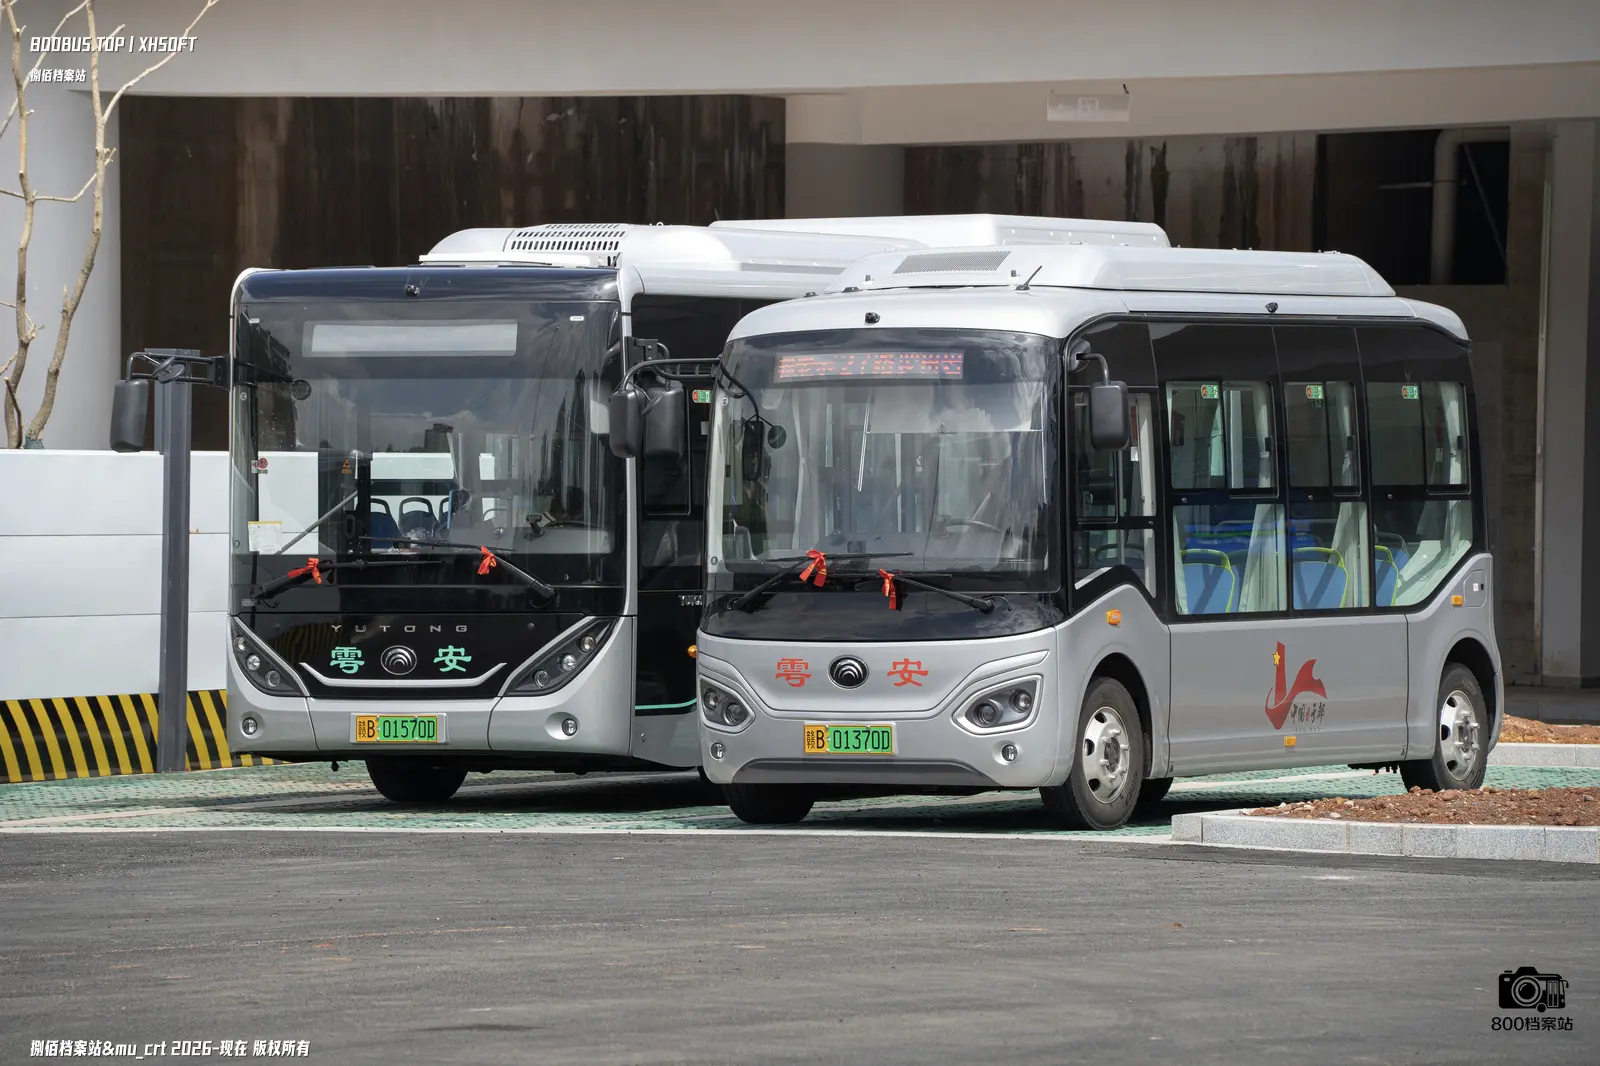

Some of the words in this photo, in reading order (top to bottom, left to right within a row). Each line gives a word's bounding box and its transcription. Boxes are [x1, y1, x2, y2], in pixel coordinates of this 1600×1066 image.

[331, 625, 468, 633] YUTONG
[433, 644, 472, 673] 安
[886, 657, 929, 687] 安
